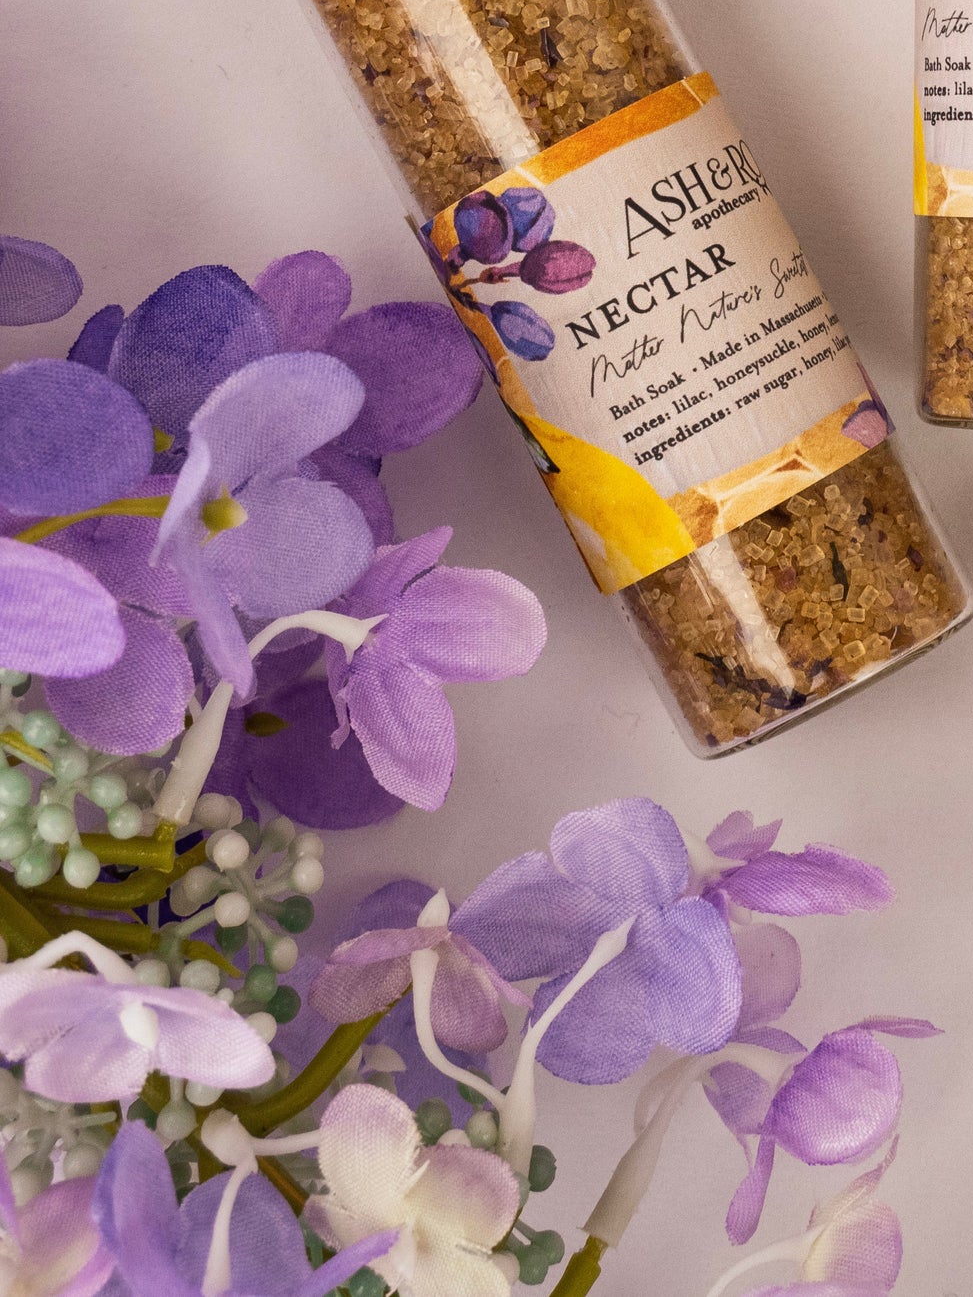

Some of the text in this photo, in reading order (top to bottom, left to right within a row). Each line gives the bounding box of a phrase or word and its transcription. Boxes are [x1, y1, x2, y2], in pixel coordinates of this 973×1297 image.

[922, 7, 972, 41] Mother
[925, 57, 942, 71] Bath
[945, 56, 971, 71] Soak
[924, 86, 950, 97] notes:
[692, 187, 761, 230] apothecary
[565, 244, 736, 349] NECTAR
[591, 334, 664, 398] Mother
[680, 285, 762, 343] Nature's
[609, 396, 646, 420] Bath
[646, 372, 686, 400] Soak
[699, 342, 743, 370] Made
[745, 331, 761, 347] in
[622, 411, 671, 443] notes:
[674, 390, 713, 415] lilac,
[713, 338, 800, 391] honeysuckle,
[798, 322, 830, 343] honey,
[634, 406, 731, 465] ingredients:
[735, 389, 761, 409] raw
[764, 366, 803, 393] sugar,
[804, 346, 836, 370] honey,
